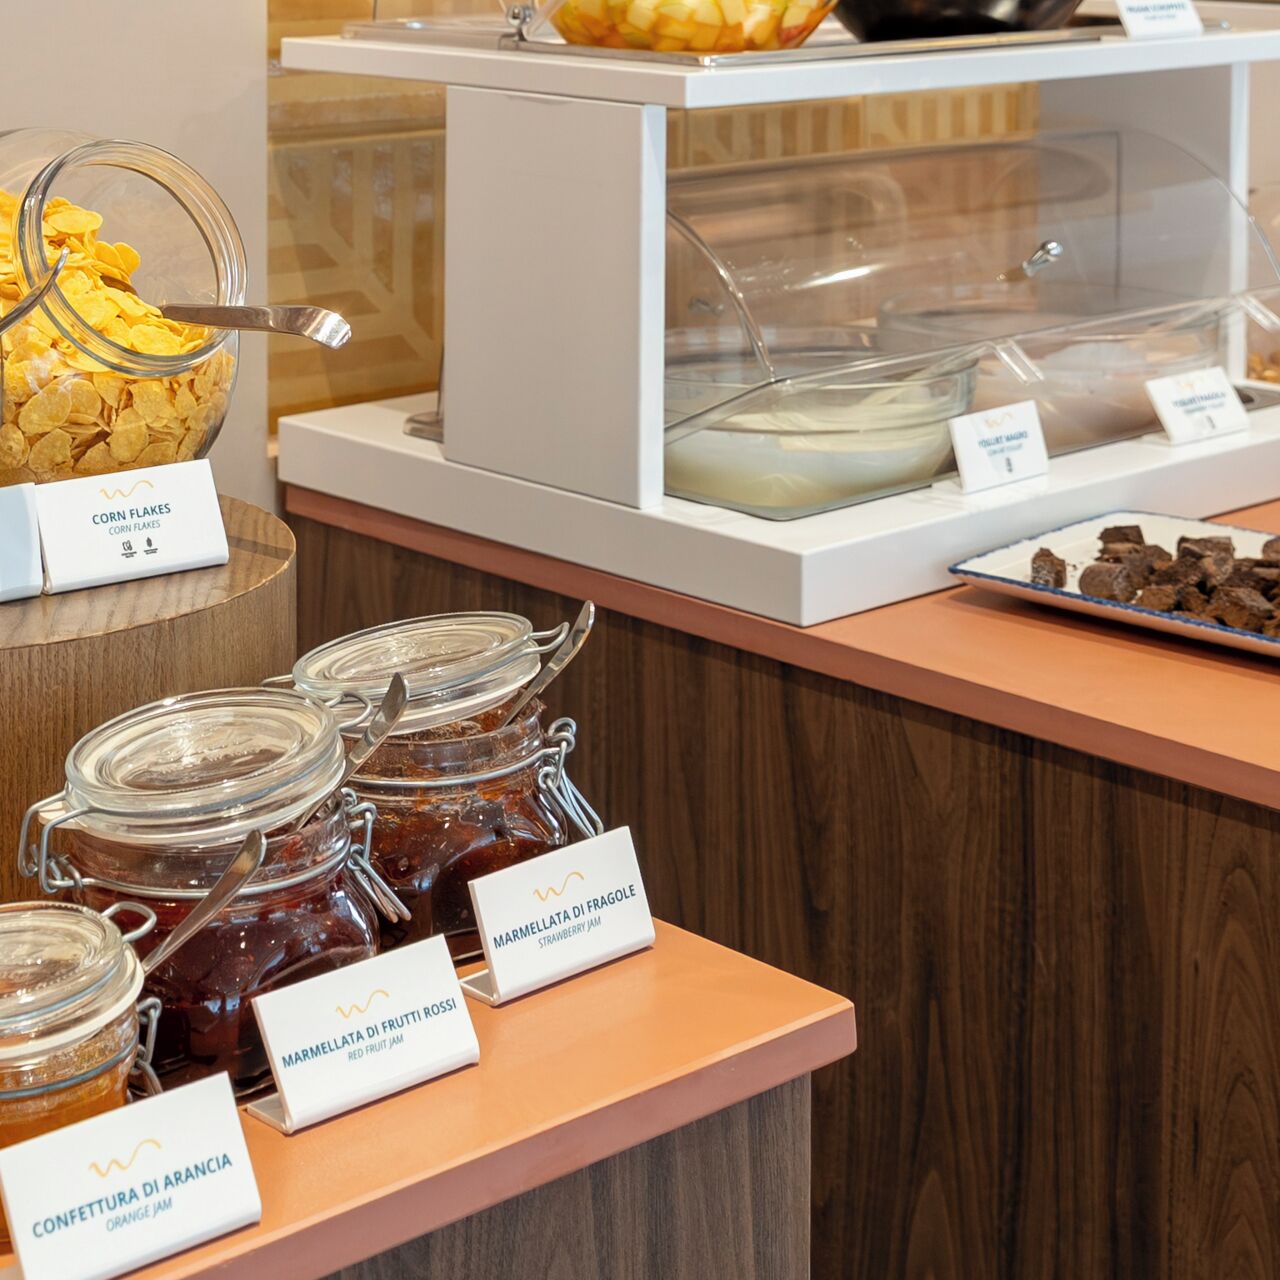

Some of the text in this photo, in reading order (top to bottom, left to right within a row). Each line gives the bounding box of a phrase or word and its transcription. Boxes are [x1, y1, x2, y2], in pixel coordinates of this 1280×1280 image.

[92, 503, 171, 525] CORN FLAKES
[108, 519, 161, 536] CORN FLAKES
[493, 884, 636, 949] MARMELLATA DI FRAGOLE
[538, 915, 602, 949] STRAWBERRY JAM
[281, 997, 457, 1068] MARMELLATA DI FRUTTI ROSSI
[347, 1033, 405, 1062] RED FRUIT JAM
[32, 1152, 233, 1239] CONFETTURA DI ARANCIA
[106, 1196, 173, 1232] ORANGE JAM
